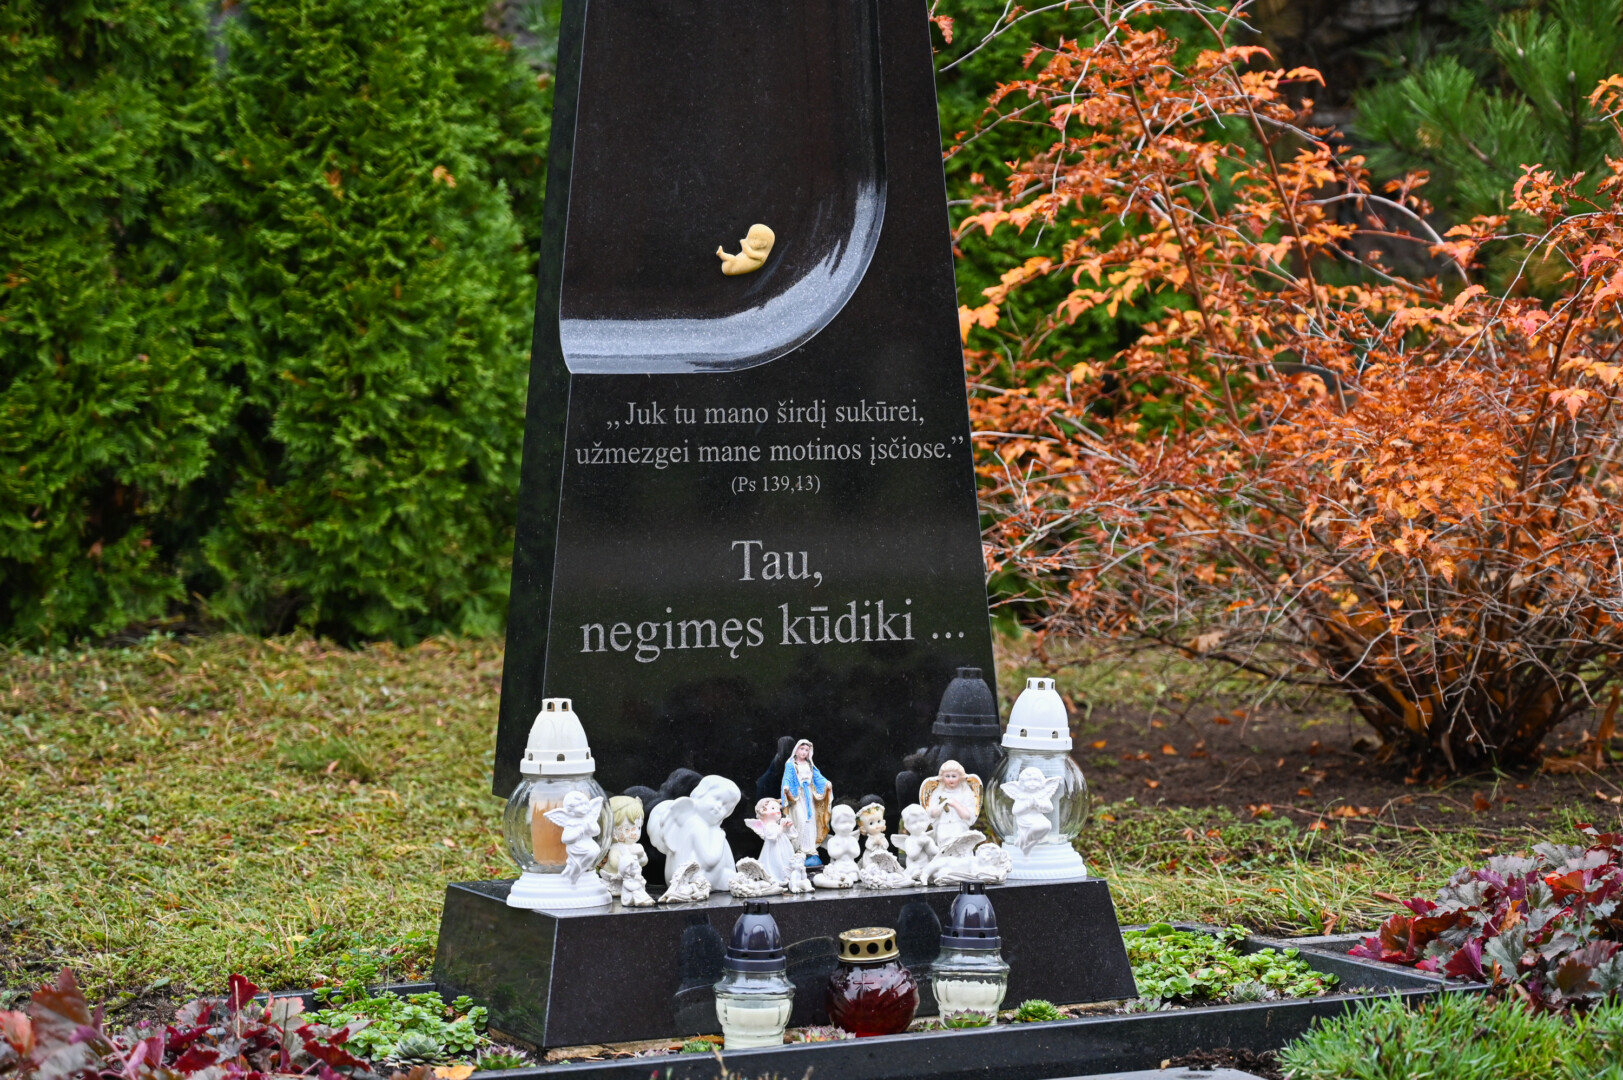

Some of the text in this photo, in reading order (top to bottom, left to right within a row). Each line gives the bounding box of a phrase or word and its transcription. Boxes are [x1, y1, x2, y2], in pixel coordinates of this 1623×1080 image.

[606, 398, 925, 430] „Juk tu mano širdį sukūrei,
[574, 435, 964, 470] užmezgei mane motinos įsčiose.”
[731, 474, 821, 496] (Ps 139,13)
[731, 539, 823, 588] Tau,
[579, 606, 765, 664] negimęs
[777, 597, 916, 646] kūdiki
